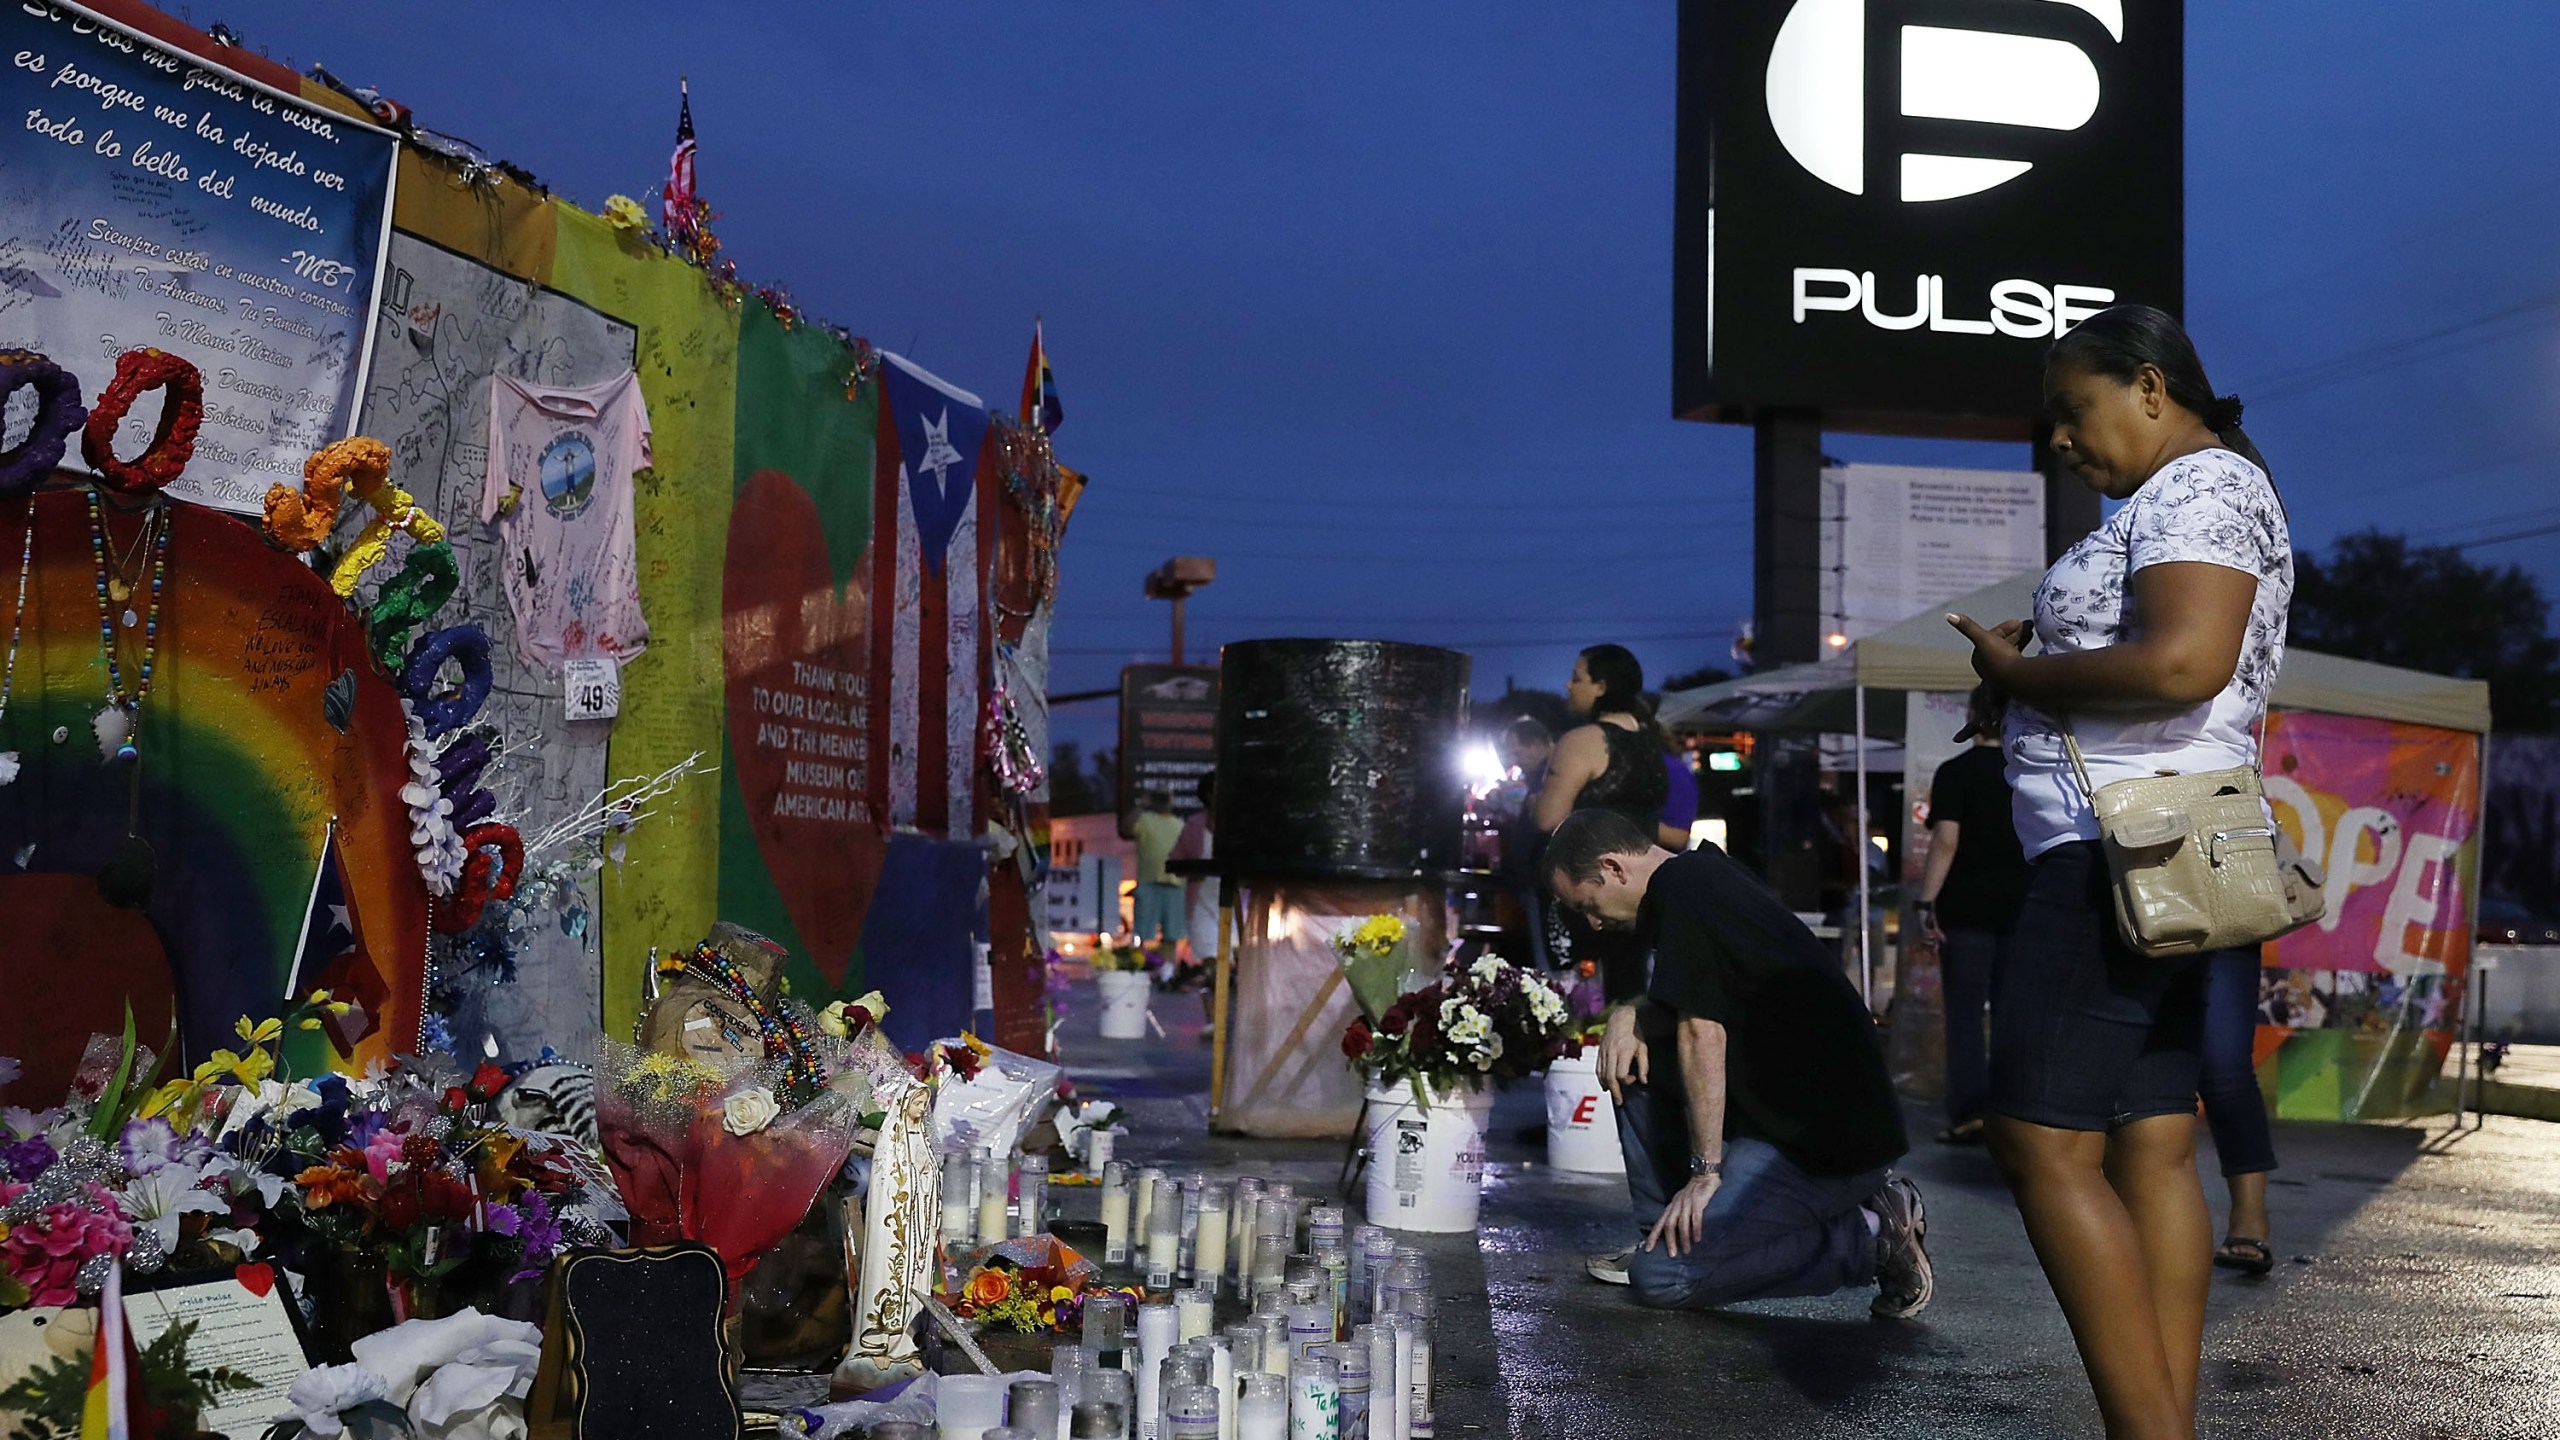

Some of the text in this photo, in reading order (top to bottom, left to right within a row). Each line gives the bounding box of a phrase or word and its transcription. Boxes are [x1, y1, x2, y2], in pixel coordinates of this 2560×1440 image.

[72, 14, 134, 54] Dios
[143, 47, 178, 74] me
[251, 90, 275, 116] la
[282, 108, 340, 144] vista.
[14, 50, 345, 192] es porque me ha dejado ver
[26, 108, 85, 146] todo
[95, 129, 121, 158] lo
[132, 141, 189, 182] bello
[198, 169, 235, 200] del
[251, 195, 325, 235] mundo.
[87, 218, 161, 256] Siempre
[165, 248, 209, 270] estas
[214, 263, 234, 278] en
[237, 271, 296, 298] nuestros
[134, 266, 154, 291] Te
[155, 278, 228, 314] Amamos,
[239, 297, 259, 321] Tu
[1793, 267, 2115, 340] PULSE
[155, 312, 177, 336] Tu
[241, 332, 293, 369] Miriam
[218, 368, 283, 402] Damaris
[285, 393, 294, 410] y
[295, 387, 336, 419] Nelly
[201, 403, 264, 436] Sobrinos
[130, 420, 151, 444] Tu
[241, 448, 302, 476] Gabriel
[213, 477, 266, 504] Micha
[581, 684, 604, 712] 49
[792, 661, 836, 691] THANK
[752, 687, 869, 730] TO OUR LOCAL AR
[757, 722, 788, 749] AND
[820, 734, 867, 761] MENNE
[786, 761, 844, 789] MUSEUM
[774, 793, 847, 820] AMERICAN
[2262, 775, 2463, 976] OPE
[703, 999, 763, 1042] CONFIDENCE
[1456, 1151, 1475, 1164] YOU
